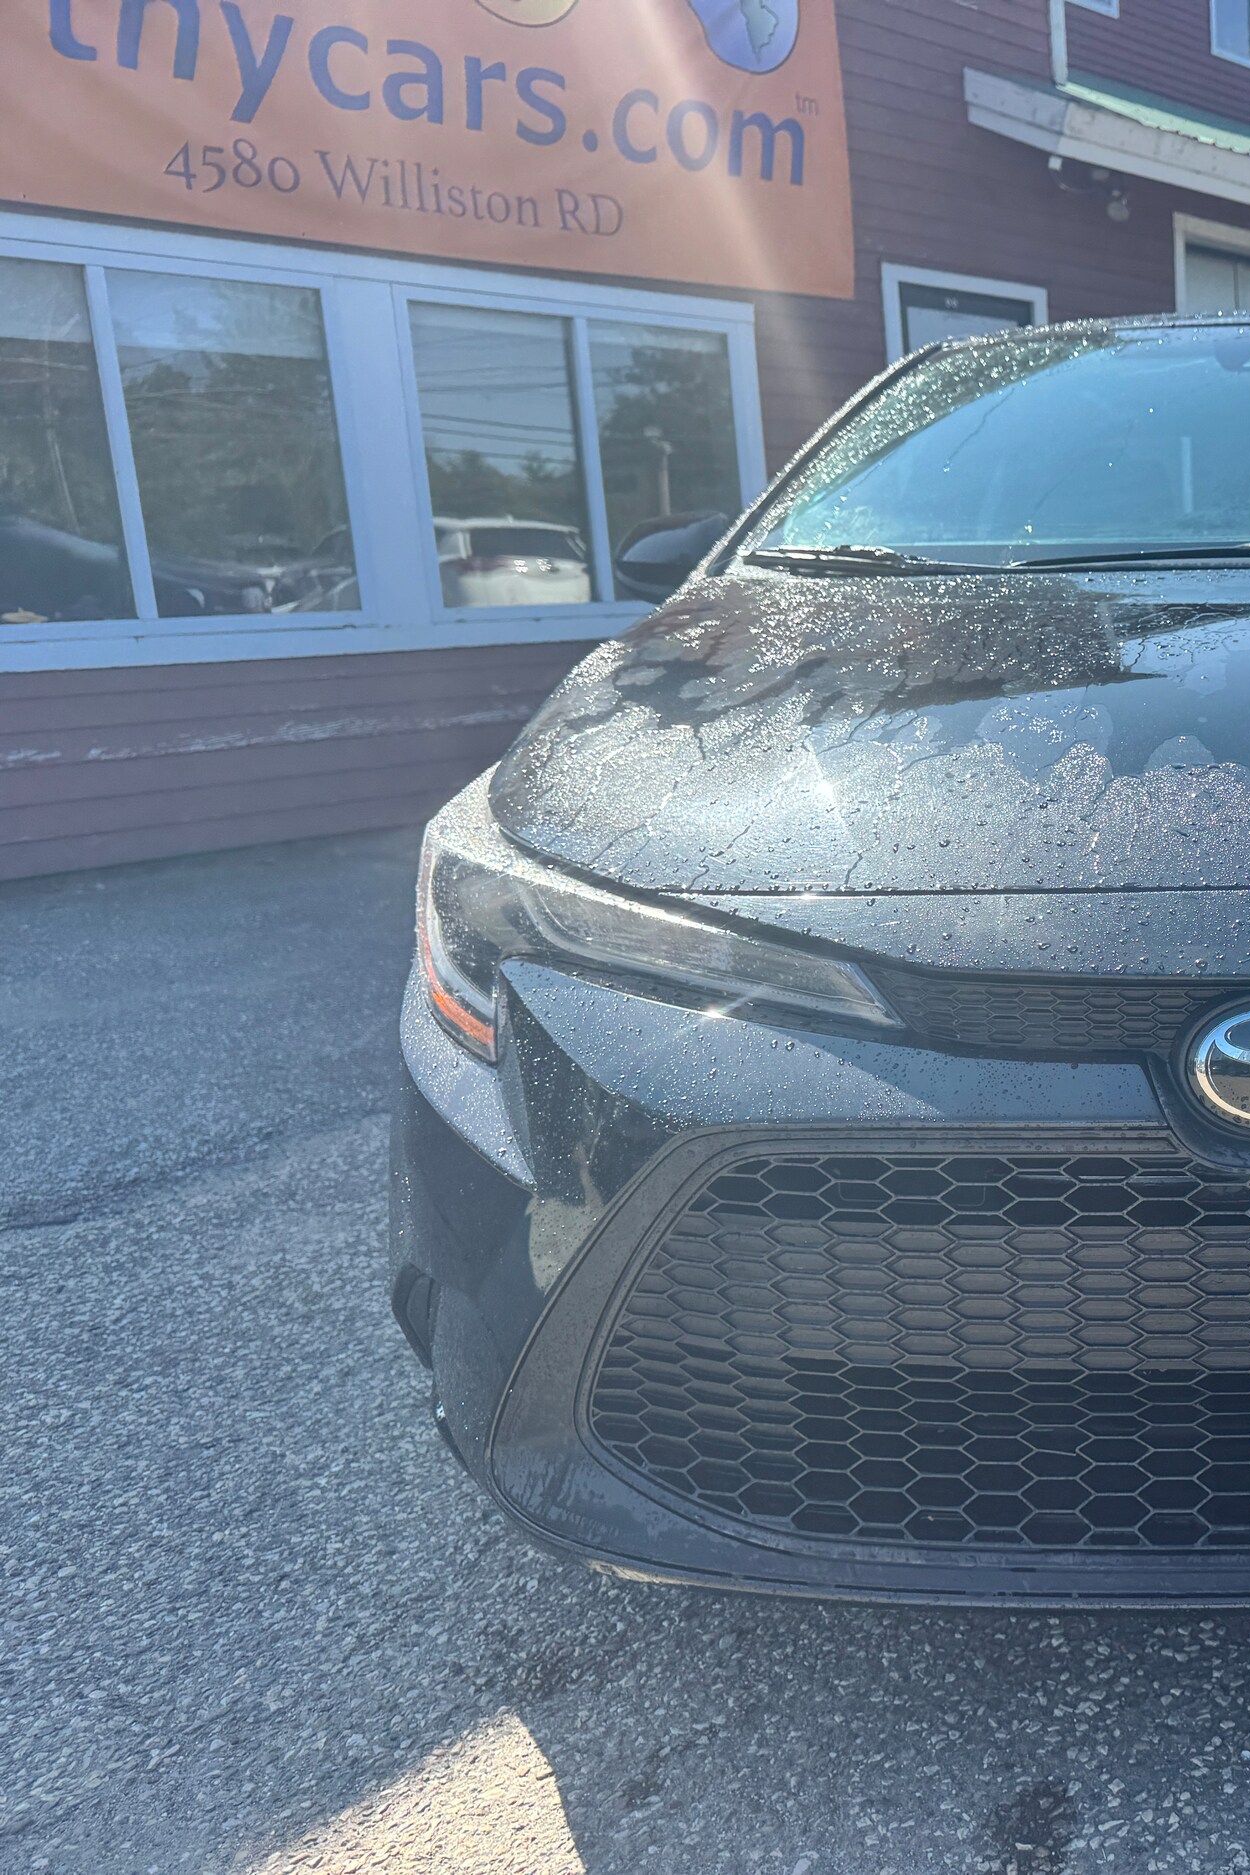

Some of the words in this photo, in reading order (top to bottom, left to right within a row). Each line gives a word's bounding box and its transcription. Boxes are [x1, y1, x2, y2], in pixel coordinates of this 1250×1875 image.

[163, 138, 300, 193] 4580
[313, 149, 541, 228] Williston
[554, 188, 624, 237] RD
